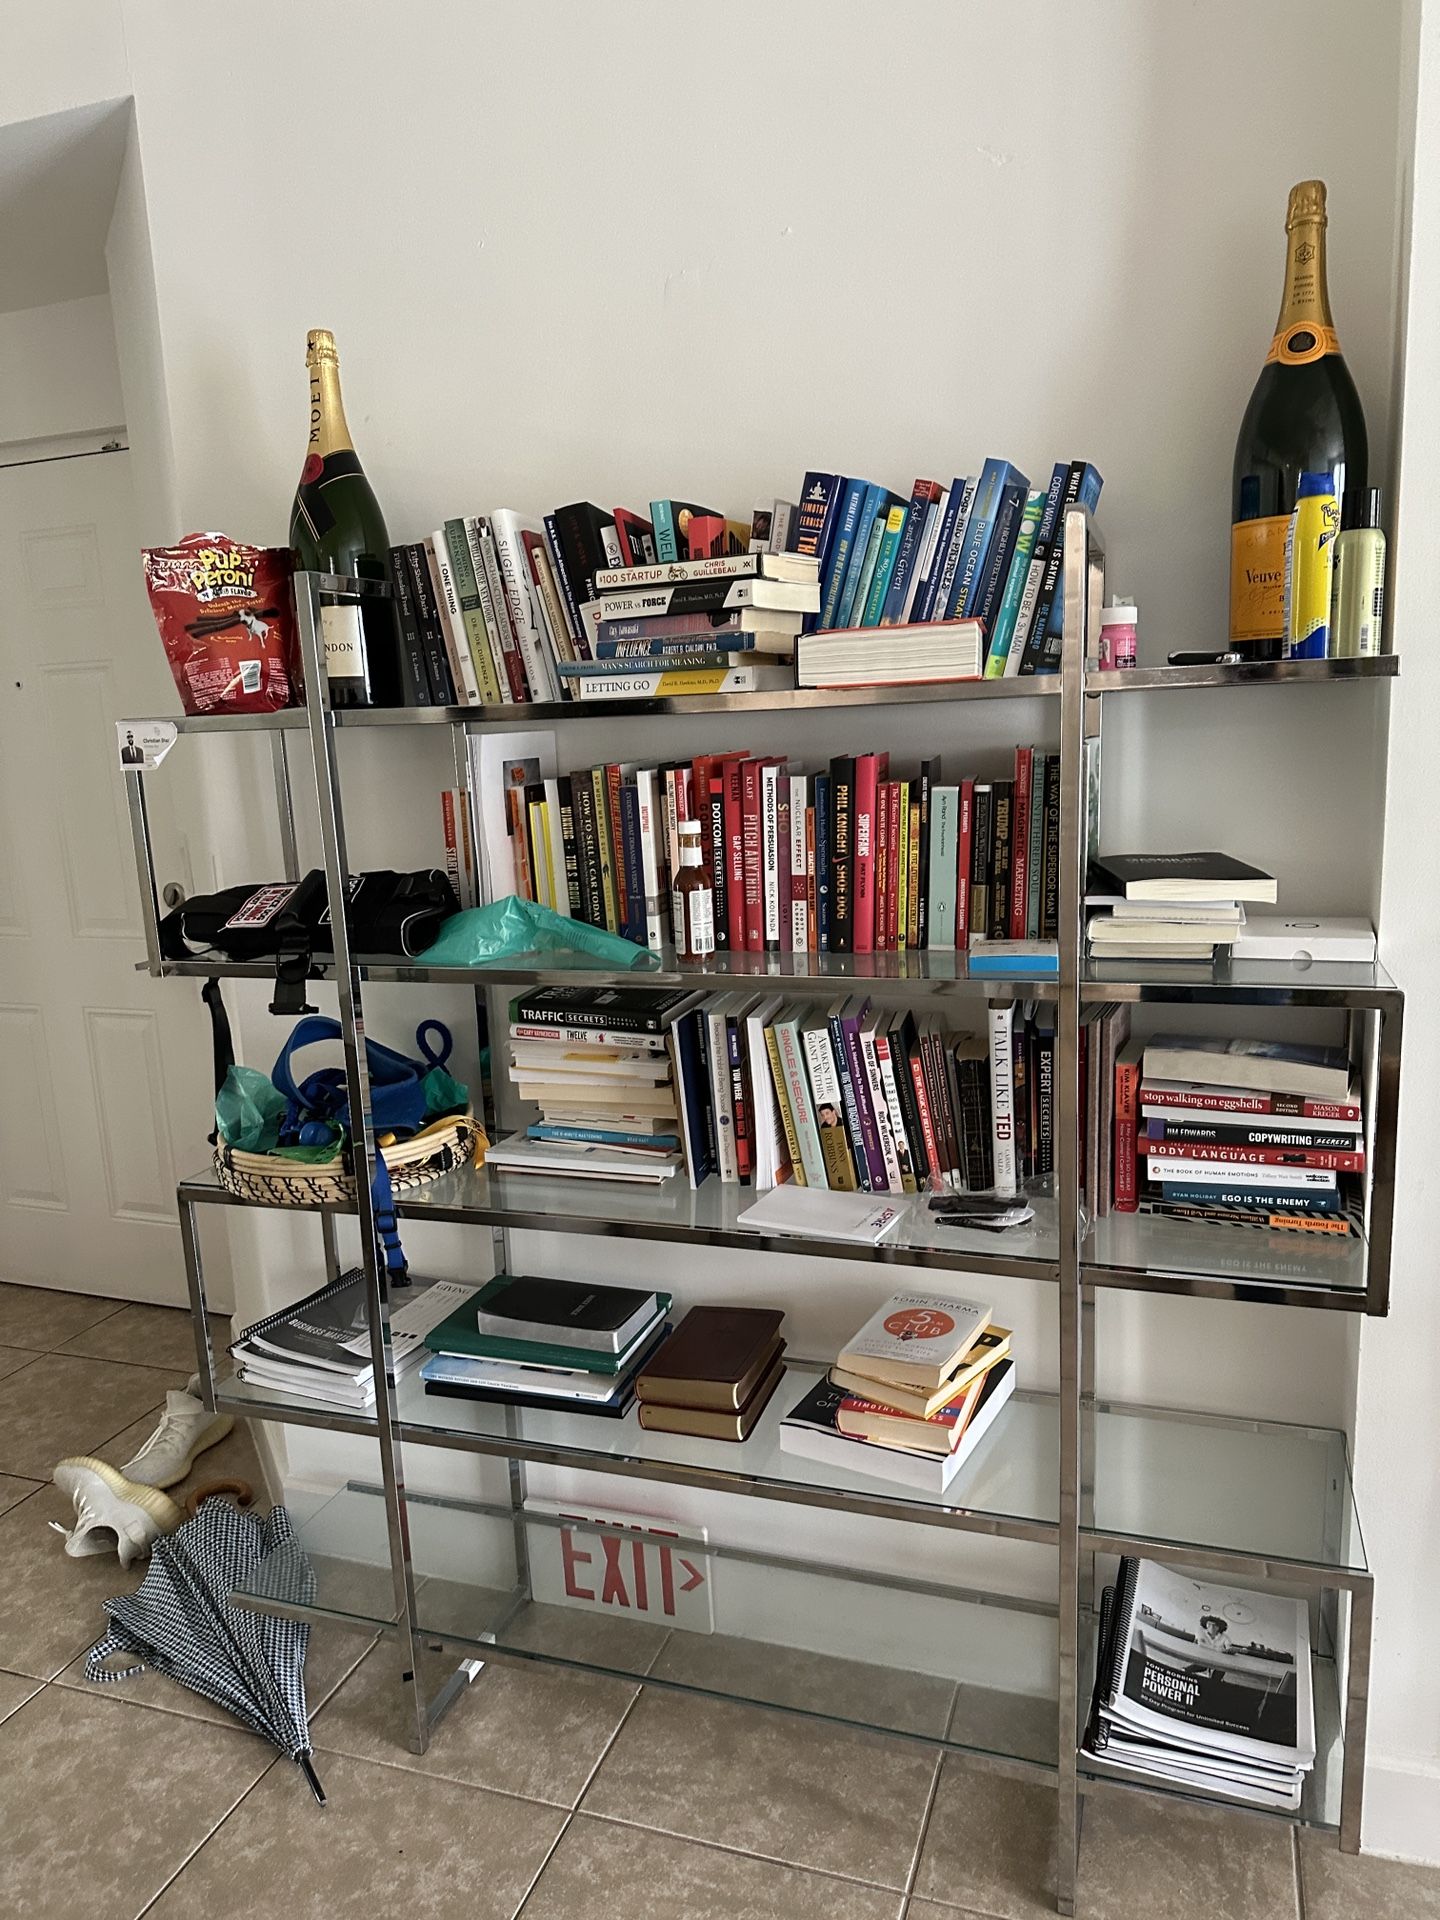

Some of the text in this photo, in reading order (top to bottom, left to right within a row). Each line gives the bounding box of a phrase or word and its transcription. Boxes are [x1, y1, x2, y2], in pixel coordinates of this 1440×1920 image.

[802, 502, 828, 514] TIMOTHY
[1038, 474, 1062, 538] COREY WAYNE
[800, 516, 824, 528] FERRISS
[972, 521, 985, 548] BLUE
[448, 525, 467, 589] SUPERNATURAL
[456, 533, 470, 577] BECOMING
[705, 560, 725, 569] CHRIS
[961, 548, 978, 585] OCEAN
[190, 569, 255, 590] Peroni
[390, 552, 411, 615] Fifty Shades Freed
[407, 550, 429, 619] Fifty Shades Darker
[466, 527, 494, 624] THE MILLIONAIRE NEXT DOOR
[497, 539, 525, 625] SLIGHT EDGE
[600, 570, 662, 584] $100 STARTUP
[694, 566, 737, 577] GUILLEBEAU
[867, 539, 892, 621] THE 80/20 PRINCIPLE
[1027, 563, 1041, 586] HOW
[1246, 569, 1281, 585] Veuve
[441, 567, 456, 614] ONE THING
[605, 602, 633, 612] POWER
[642, 597, 667, 607] FORCE
[952, 586, 968, 620] STRAT
[1023, 586, 1035, 599] TO
[1020, 598, 1032, 612] BE
[1009, 633, 1023, 655] MAN
[601, 662, 624, 670] MAN'S
[625, 661, 652, 669] SEARCH
[654, 660, 670, 668] FOR
[672, 657, 706, 667] MEANING
[586, 681, 650, 693] LETTING GO
[581, 791, 590, 816] HOW
[560, 806, 574, 840] WINNING
[584, 819, 592, 832] TO
[711, 802, 721, 847] DOTCOM
[766, 813, 773, 824] OF
[995, 798, 1009, 839] TRUMP
[585, 834, 594, 856] SELL
[856, 813, 869, 856] SUPERFANS
[1030, 771, 1043, 895] THE UNTETHERED SOUL
[1046, 763, 1058, 914] THE WAY OF THE SUPERIOR MAN
[732, 835, 741, 880] GAP SELLING
[743, 814, 760, 904] PITCH ANYTHING
[835, 784, 848, 919] PHIL KNIGHT SHOE DOG
[1013, 801, 1026, 916] MAGNETIC MARKETING
[588, 867, 597, 888] CAR
[590, 890, 600, 922] TODAY
[521, 1009, 605, 1024] TRAFFIC SECRETS
[567, 1030, 587, 1040] TWELVE
[767, 1034, 785, 1097] THE PROPHET
[805, 1031, 826, 1100] GIANT WITHIN
[817, 1034, 835, 1094] AWAKEN THE
[863, 1040, 880, 1091] FRIEND OF SINNERS
[1040, 1050, 1051, 1094] EXPERT
[994, 1026, 1010, 1140] TALK LIKE TED
[730, 1067, 746, 1136] YOU WERE BORN RICH
[913, 1074, 934, 1149] THE MAGIC OF BELIEVING
[1144, 1092, 1263, 1111] stop walking on eggshells
[1312, 1110, 1340, 1118] KREGER
[824, 1131, 839, 1174] ROBBINS
[836, 1141, 846, 1163] TONY
[1249, 1132, 1350, 1146] COPYWRITING SECRETS
[1150, 1146, 1265, 1163] BODY LANGUAGE
[1221, 1194, 1241, 1203] EGO
[1255, 1196, 1273, 1204] THE
[1276, 1197, 1310, 1207] ENEMY
[892, 1295, 980, 1315] ROBIN SHARMA
[909, 1310, 937, 1325] 5
[288, 1317, 324, 1337] BUSINESS
[888, 1321, 941, 1335] CLUB
[852, 1401, 895, 1413] TIMOTHY
[560, 1513, 680, 1616] EXIT
[1143, 1666, 1201, 1696] PERSONAL
[1146, 1661, 1199, 1684] TONY ROBBINS
[1142, 1678, 1195, 1706] POWER II
[1161, 1702, 1186, 1717] Program
[1196, 1714, 1224, 1726] Unlimited
[1225, 1720, 1250, 1731] Success
